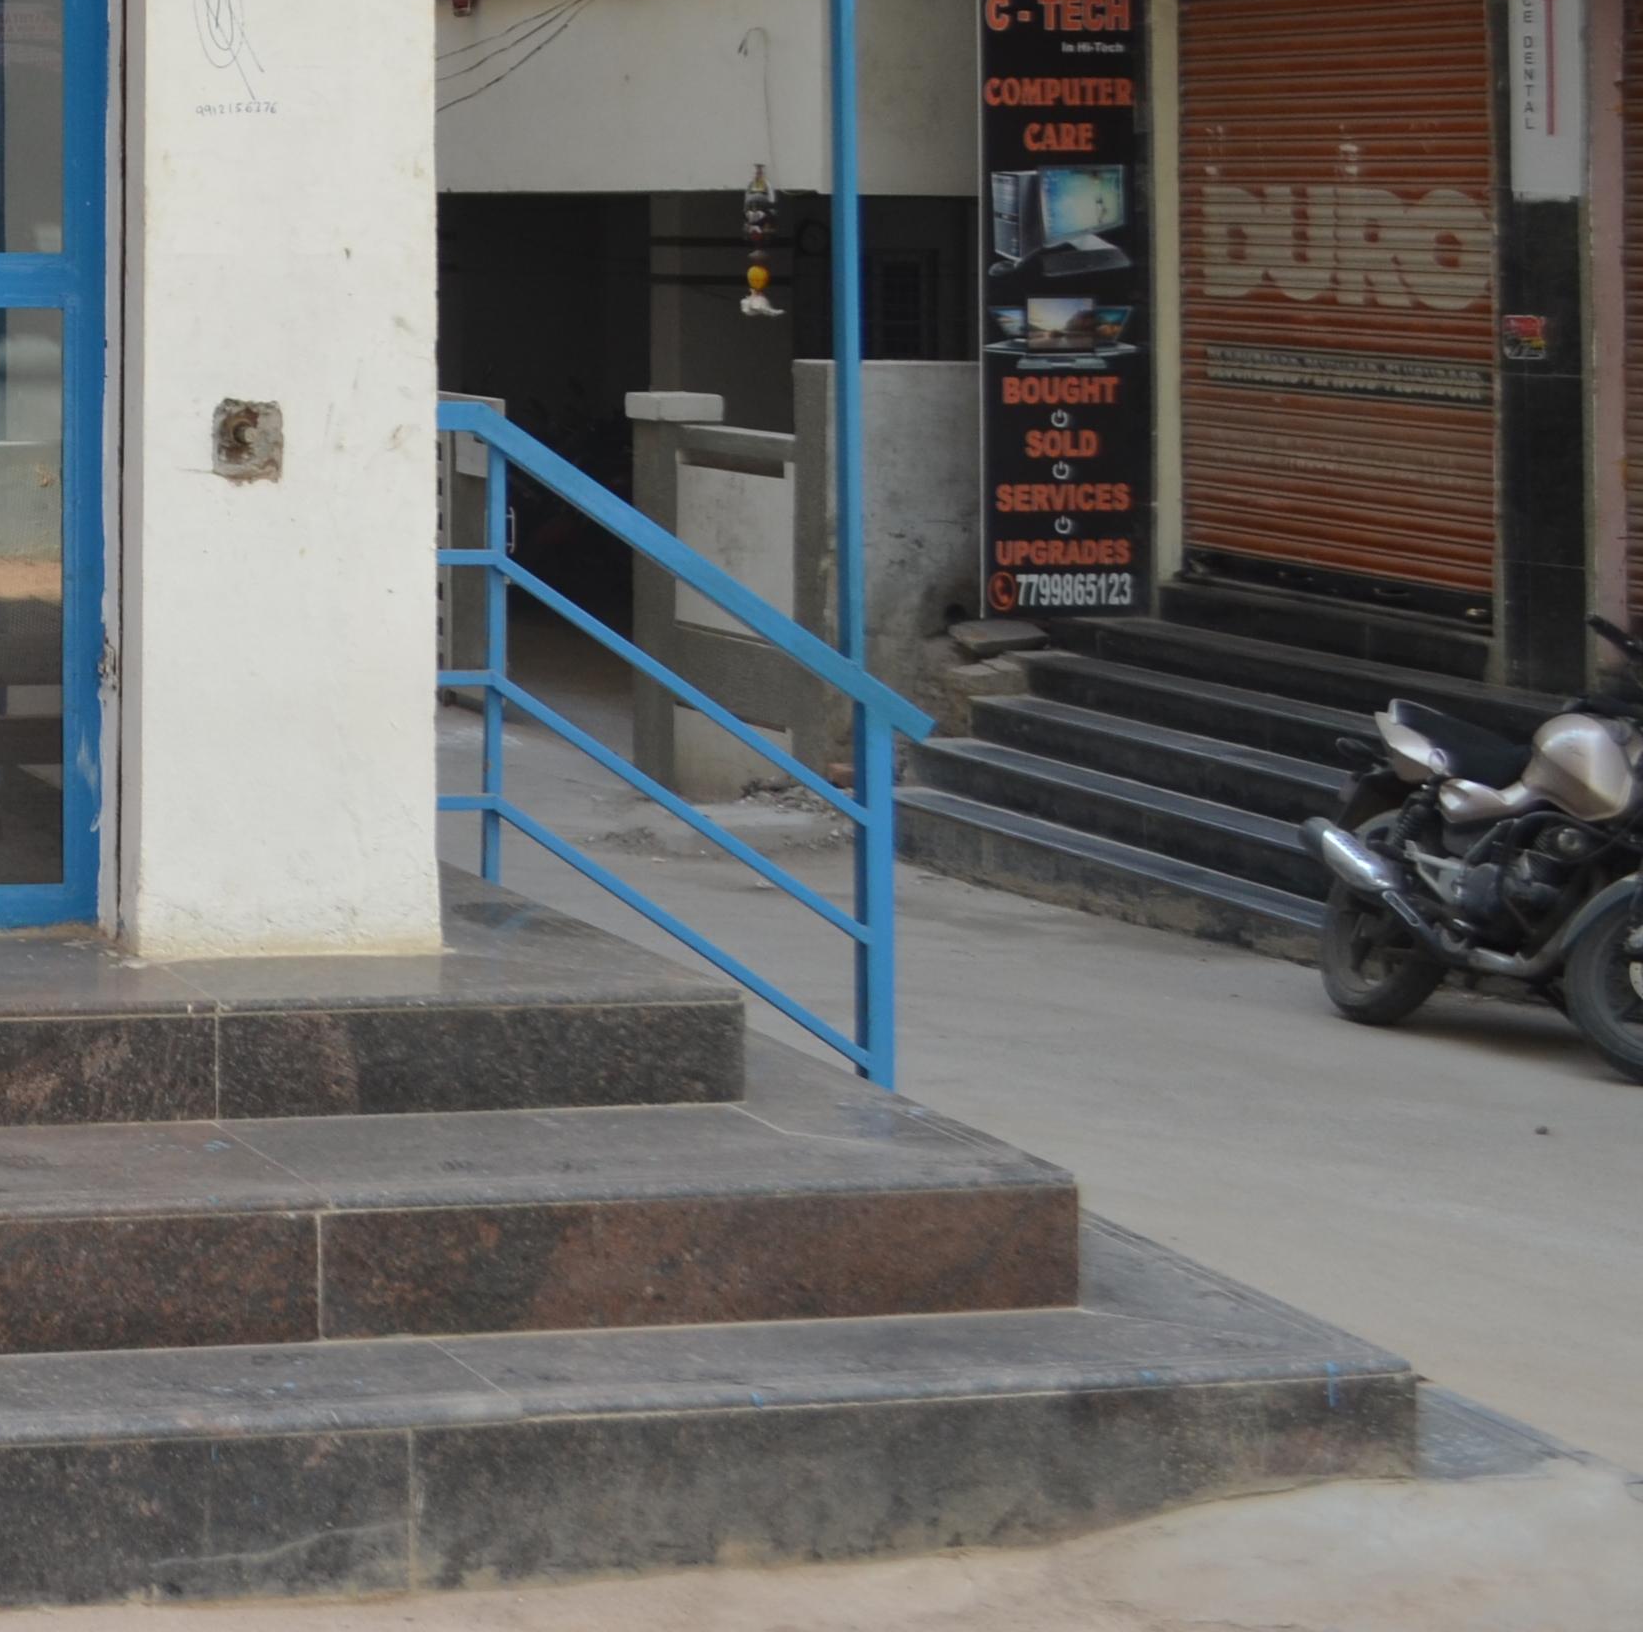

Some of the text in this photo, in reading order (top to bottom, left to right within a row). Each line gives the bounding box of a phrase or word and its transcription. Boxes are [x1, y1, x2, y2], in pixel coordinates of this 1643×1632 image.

[983, 76, 1135, 107] COMPUTER
[1023, 121, 1096, 152] CARE
[1002, 376, 1121, 405] BOUGHT
[1024, 428, 1101, 459] SOLD
[995, 482, 1133, 512] SERVICES
[995, 538, 1133, 566] UPGRADES
[1015, 572, 1133, 607] 7799865123
